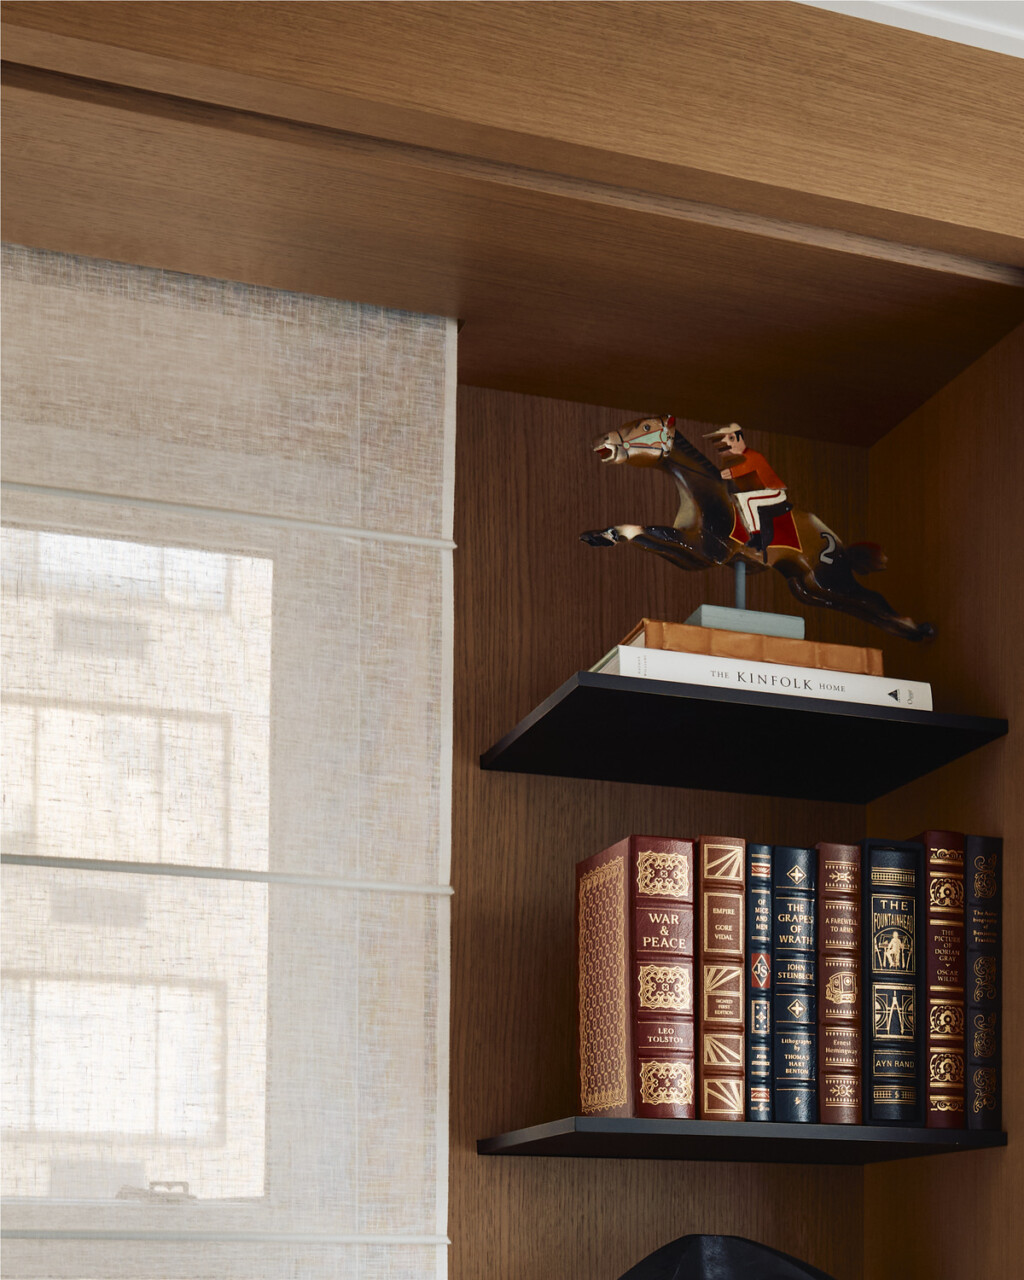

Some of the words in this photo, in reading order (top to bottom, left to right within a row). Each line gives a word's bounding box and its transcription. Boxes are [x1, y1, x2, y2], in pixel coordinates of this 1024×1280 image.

[710, 670, 730, 680] THE
[736, 670, 814, 691] KINFOLK
[818, 683, 846, 692] HOME
[757, 898, 766, 906] OF
[880, 900, 908, 911] THE
[712, 908, 736, 916] EMPIRE
[787, 903, 805, 913] THE
[648, 913, 680, 925] WAR
[777, 913, 814, 924] GRAPES
[830, 918, 858, 926] FAREWELL
[873, 912, 913, 934] FOUNTAINHEAD
[660, 925, 669, 936] &
[714, 924, 733, 932] GORE
[790, 924, 803, 934] OF
[839, 926, 854, 934] ARMS
[714, 933, 734, 941] VIDAL
[779, 934, 813, 946] WRATH
[642, 936, 686, 949] PEACE
[934, 948, 960, 956] DORIAN
[754, 962, 768, 978] JS
[787, 963, 806, 971] JOHN
[777, 972, 814, 980] STEINBECK
[658, 1027, 674, 1035] LEO
[647, 1036, 684, 1044] TOLSTOY
[825, 1047, 858, 1055] Hemingway
[875, 1059, 892, 1068] AYN
[894, 1060, 915, 1068] RAND
